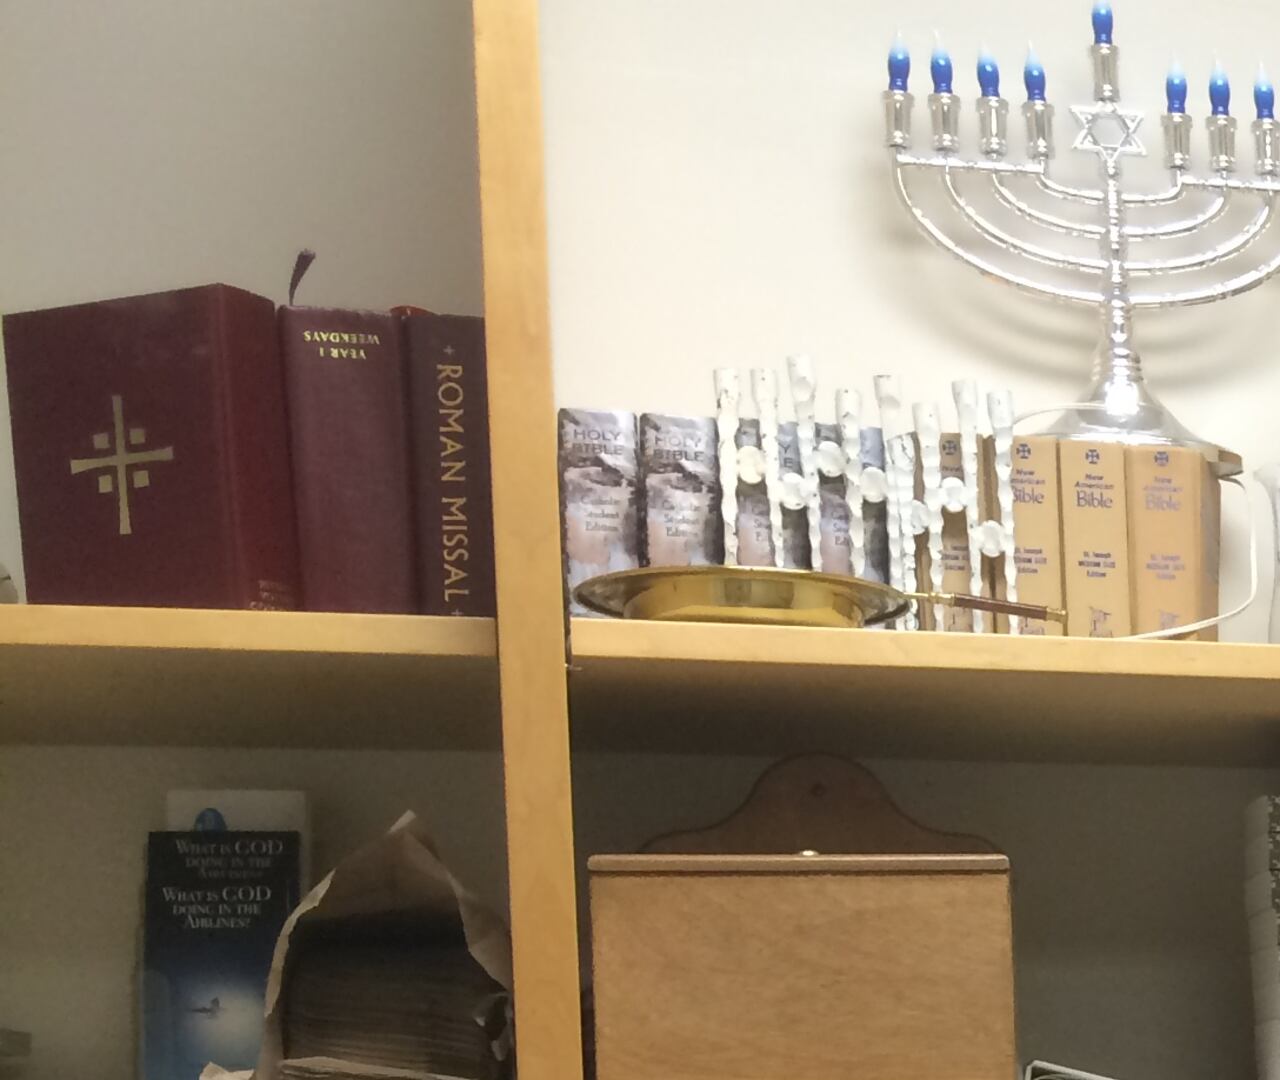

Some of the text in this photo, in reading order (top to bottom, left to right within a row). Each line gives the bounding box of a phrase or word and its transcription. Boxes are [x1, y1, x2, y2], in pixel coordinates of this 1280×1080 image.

[303, 331, 380, 345] WEEKDAYS
[331, 347, 366, 359] YEAR
[573, 429, 620, 441] HOLY
[655, 435, 702, 448] HOLY
[572, 443, 624, 455] BIBLE
[653, 449, 704, 461] BIBLE
[436, 363, 470, 603] ROMAN MISSAL
[1074, 481, 1115, 490] American
[1076, 491, 1113, 508] Bible
[1145, 494, 1182, 511] Bible
[176, 840, 217, 854] WHAT
[234, 840, 284, 855] GOD
[162, 886, 272, 902] WHAT IS GOD
[172, 904, 261, 915] DOING IN THE
